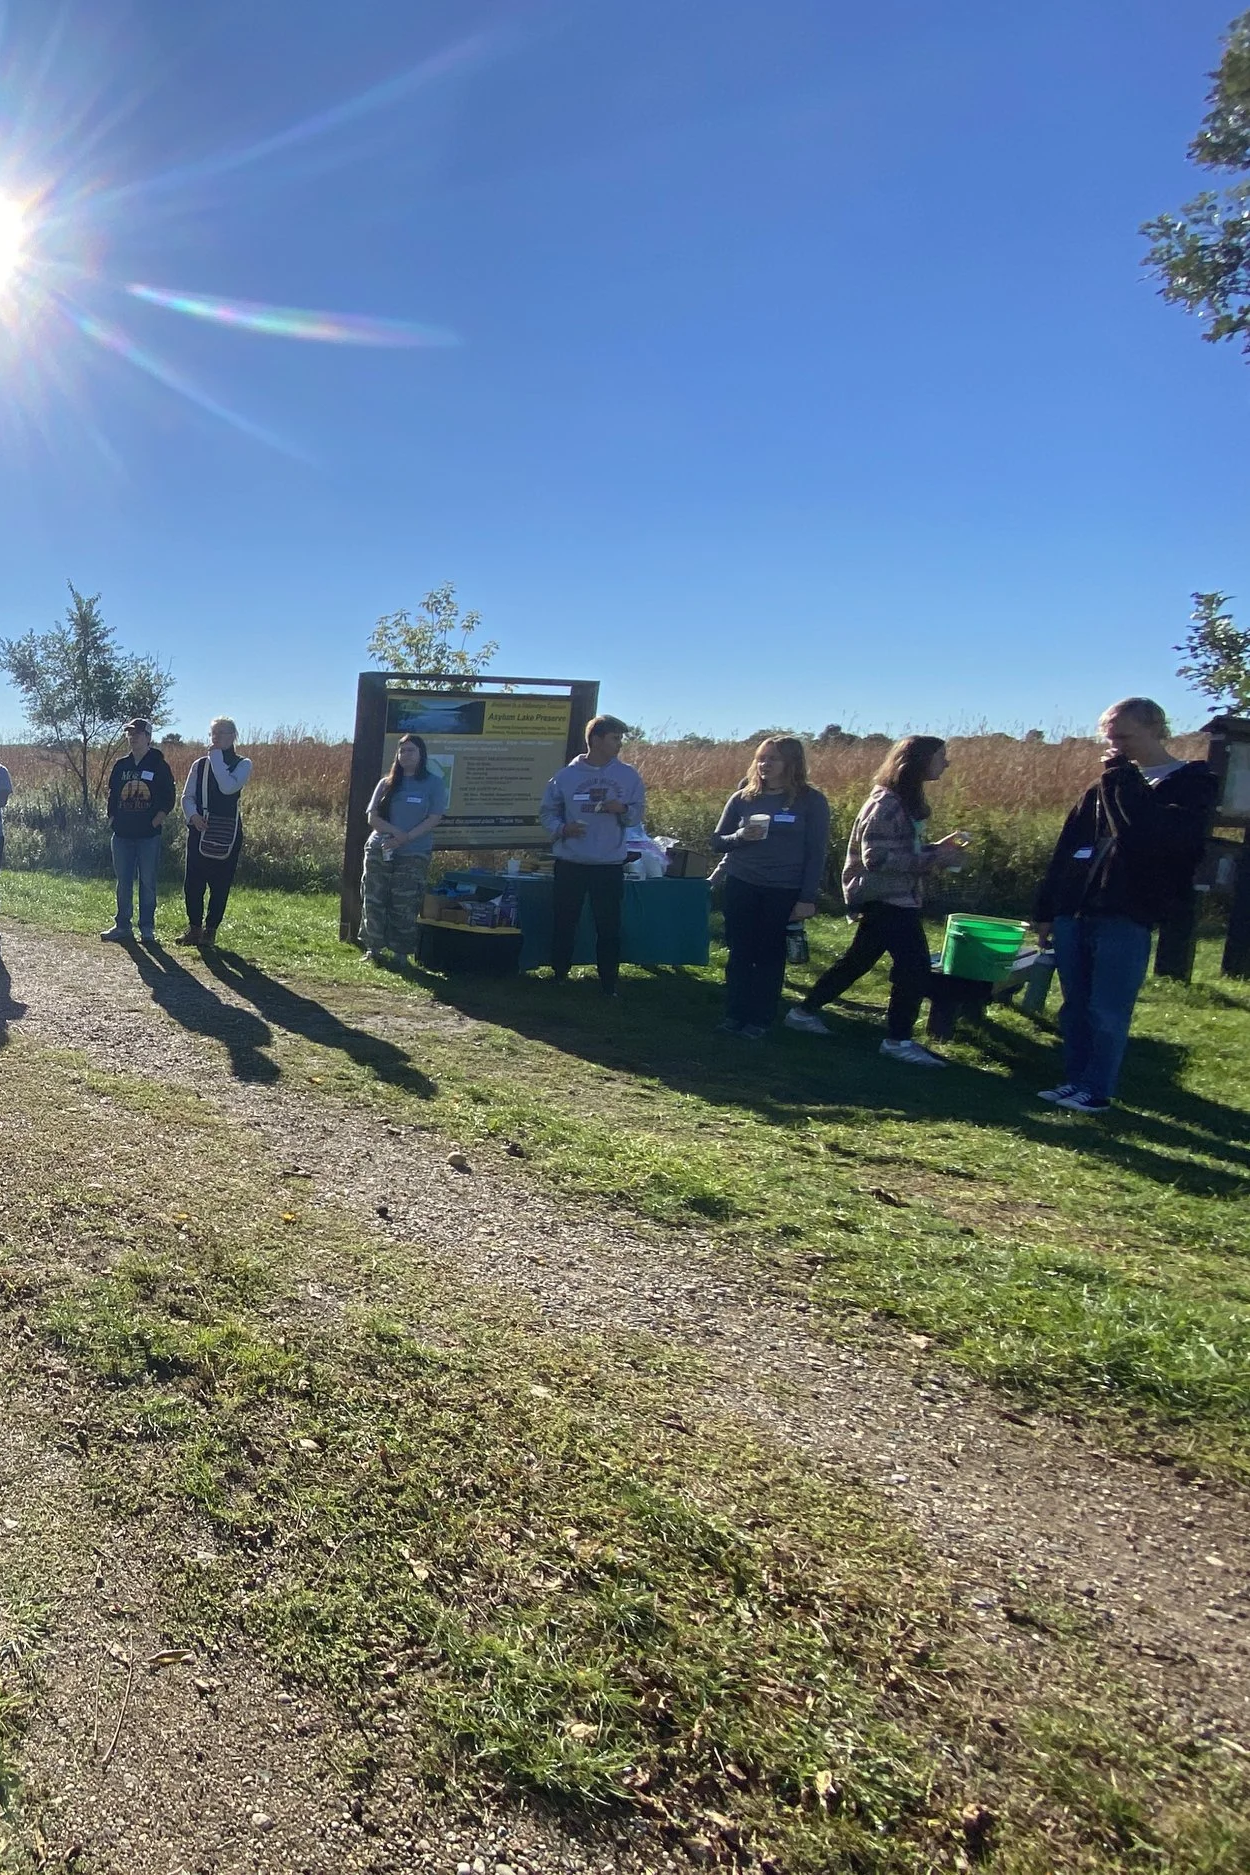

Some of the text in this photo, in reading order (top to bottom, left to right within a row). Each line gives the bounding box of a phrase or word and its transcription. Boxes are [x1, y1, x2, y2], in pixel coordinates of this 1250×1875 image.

[487, 713, 567, 722] Asylum Lake Preserve
